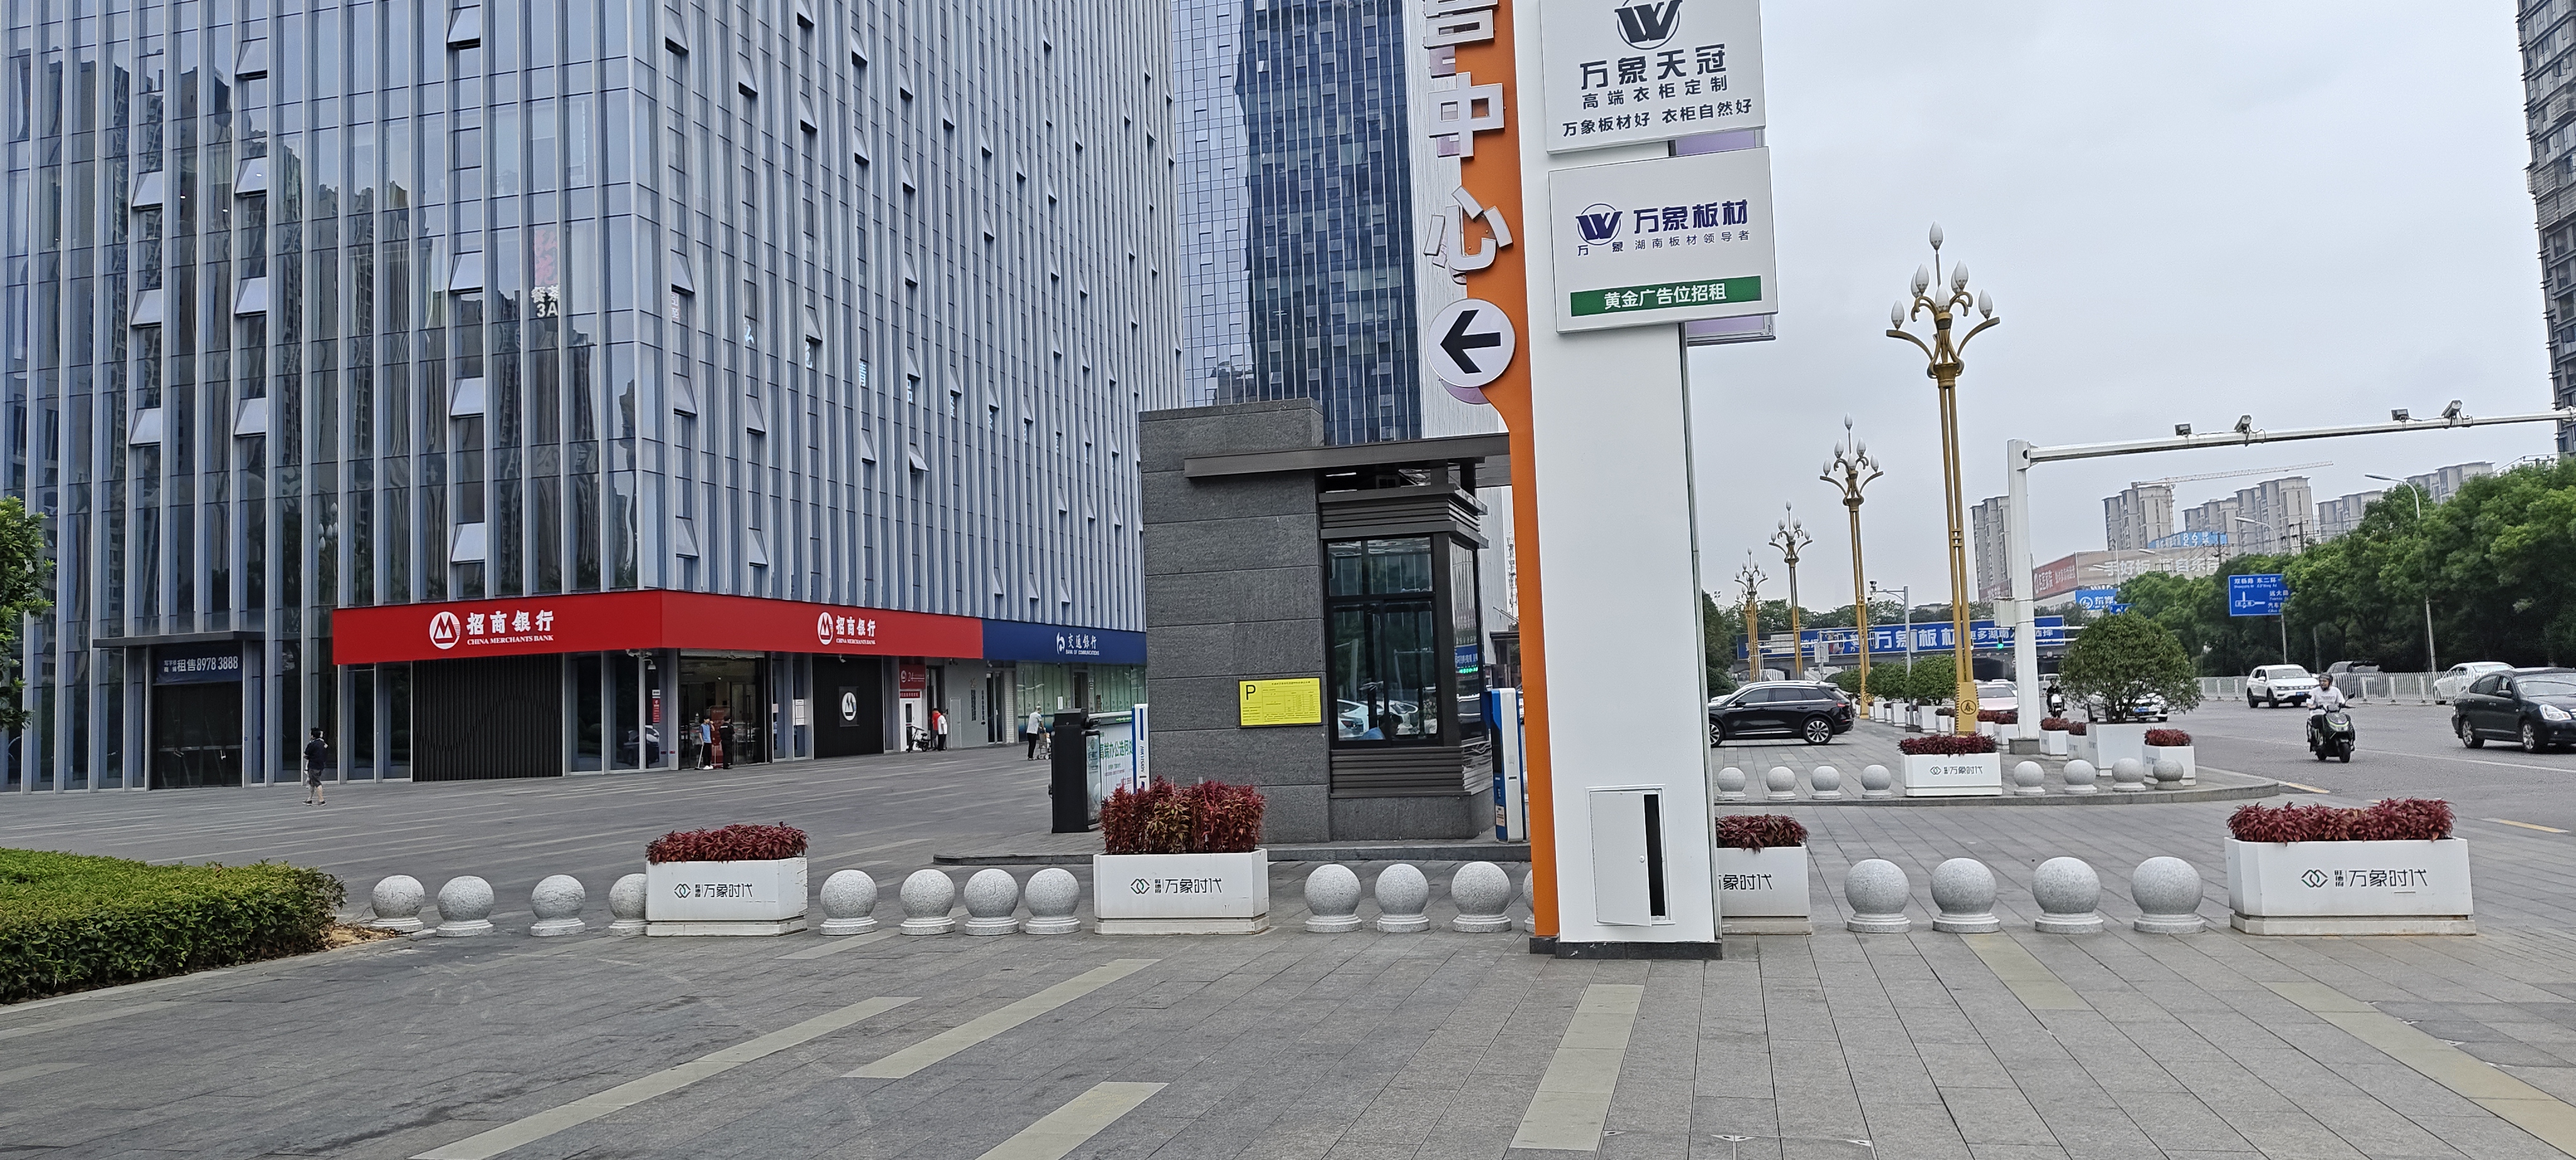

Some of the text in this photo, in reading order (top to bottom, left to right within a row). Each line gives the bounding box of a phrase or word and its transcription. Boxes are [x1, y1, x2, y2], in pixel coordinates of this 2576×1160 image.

[1580, 43, 1726, 90] 万象天冠
[1582, 75, 1727, 109] 高端衣柜定制
[1562, 99, 1752, 137] 万象板材好 衣柜自然好
[1633, 199, 1748, 234] 万象板材
[1635, 230, 1750, 250] 湖南板材领导者
[1604, 282, 1726, 310] 黄金广告位招租
[491, 636, 533, 644] MERCHANTS
[1246, 685, 1256, 700] P
[1950, 766, 1982, 774] 万象时代
[1165, 878, 1222, 893] 万象时代
[1719, 874, 1773, 890] 象时代
[2348, 869, 2428, 887] 万象时代
[704, 883, 753, 898] 万象时代
